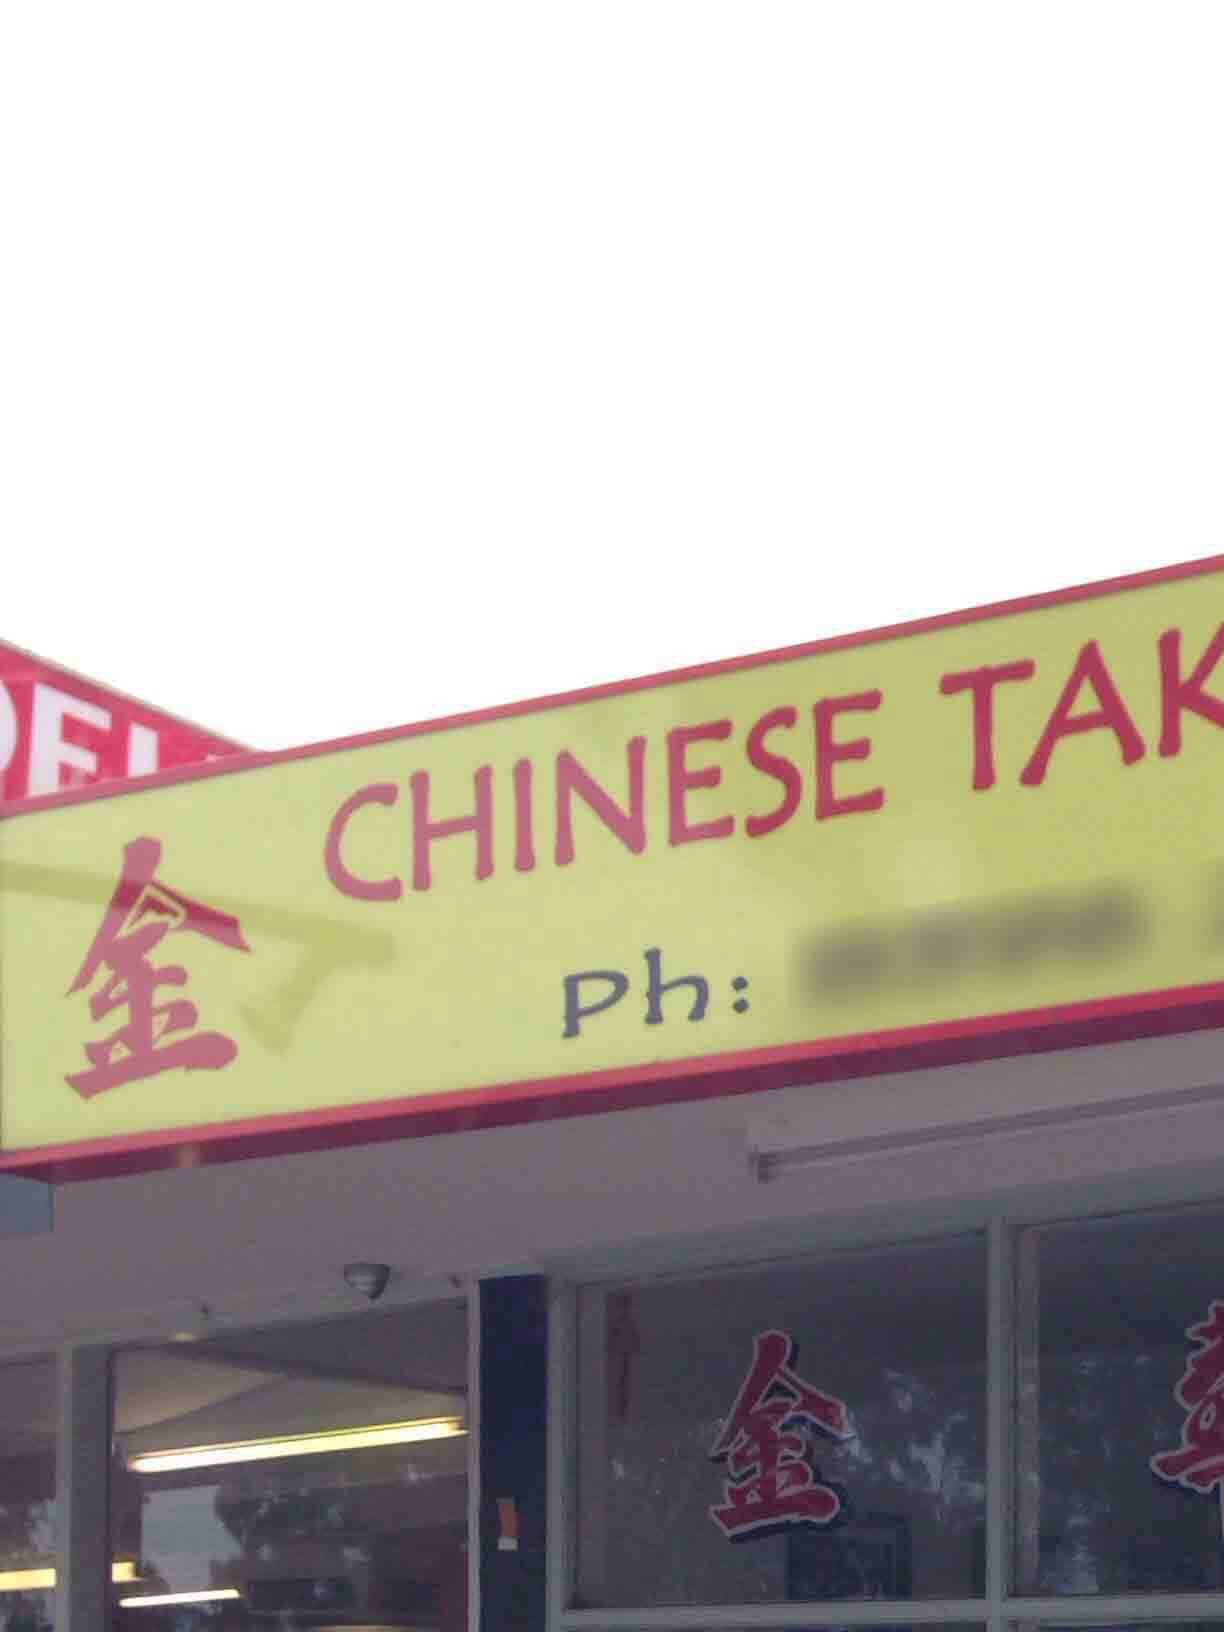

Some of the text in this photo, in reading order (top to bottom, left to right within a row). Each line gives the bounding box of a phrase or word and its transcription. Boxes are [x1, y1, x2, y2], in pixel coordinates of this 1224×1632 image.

[323, 689, 886, 902] CHINESE
[64, 835, 252, 1100] 金
[562, 946, 750, 1039] Ph:
[708, 1328, 855, 1538] 金
